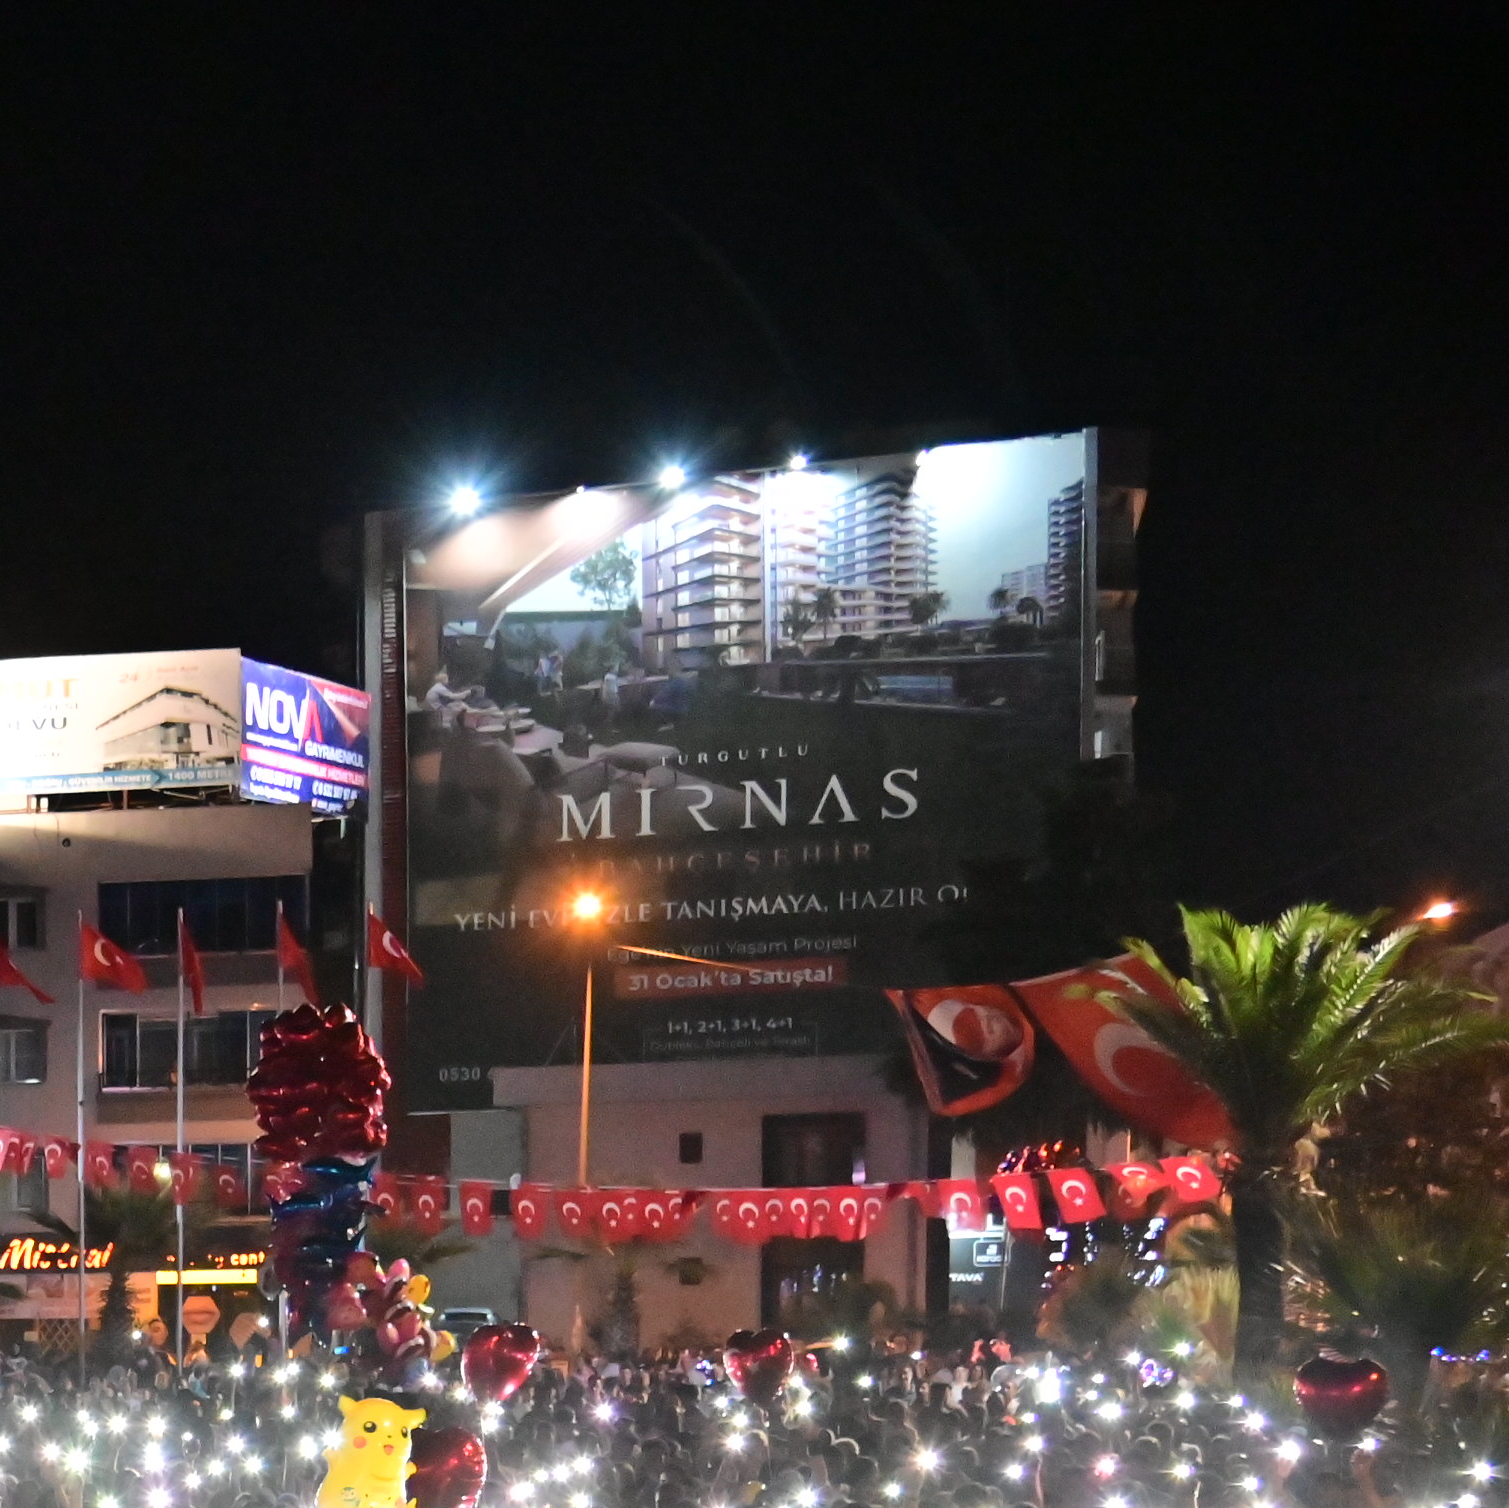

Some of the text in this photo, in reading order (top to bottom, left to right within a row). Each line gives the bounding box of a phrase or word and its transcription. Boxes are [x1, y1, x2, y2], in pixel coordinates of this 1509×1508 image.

[659, 745, 810, 767] TURGUTLU
[454, 904, 517, 932] YENİ
[839, 887, 929, 911] HAZIR
[438, 1067, 481, 1082] 0530
